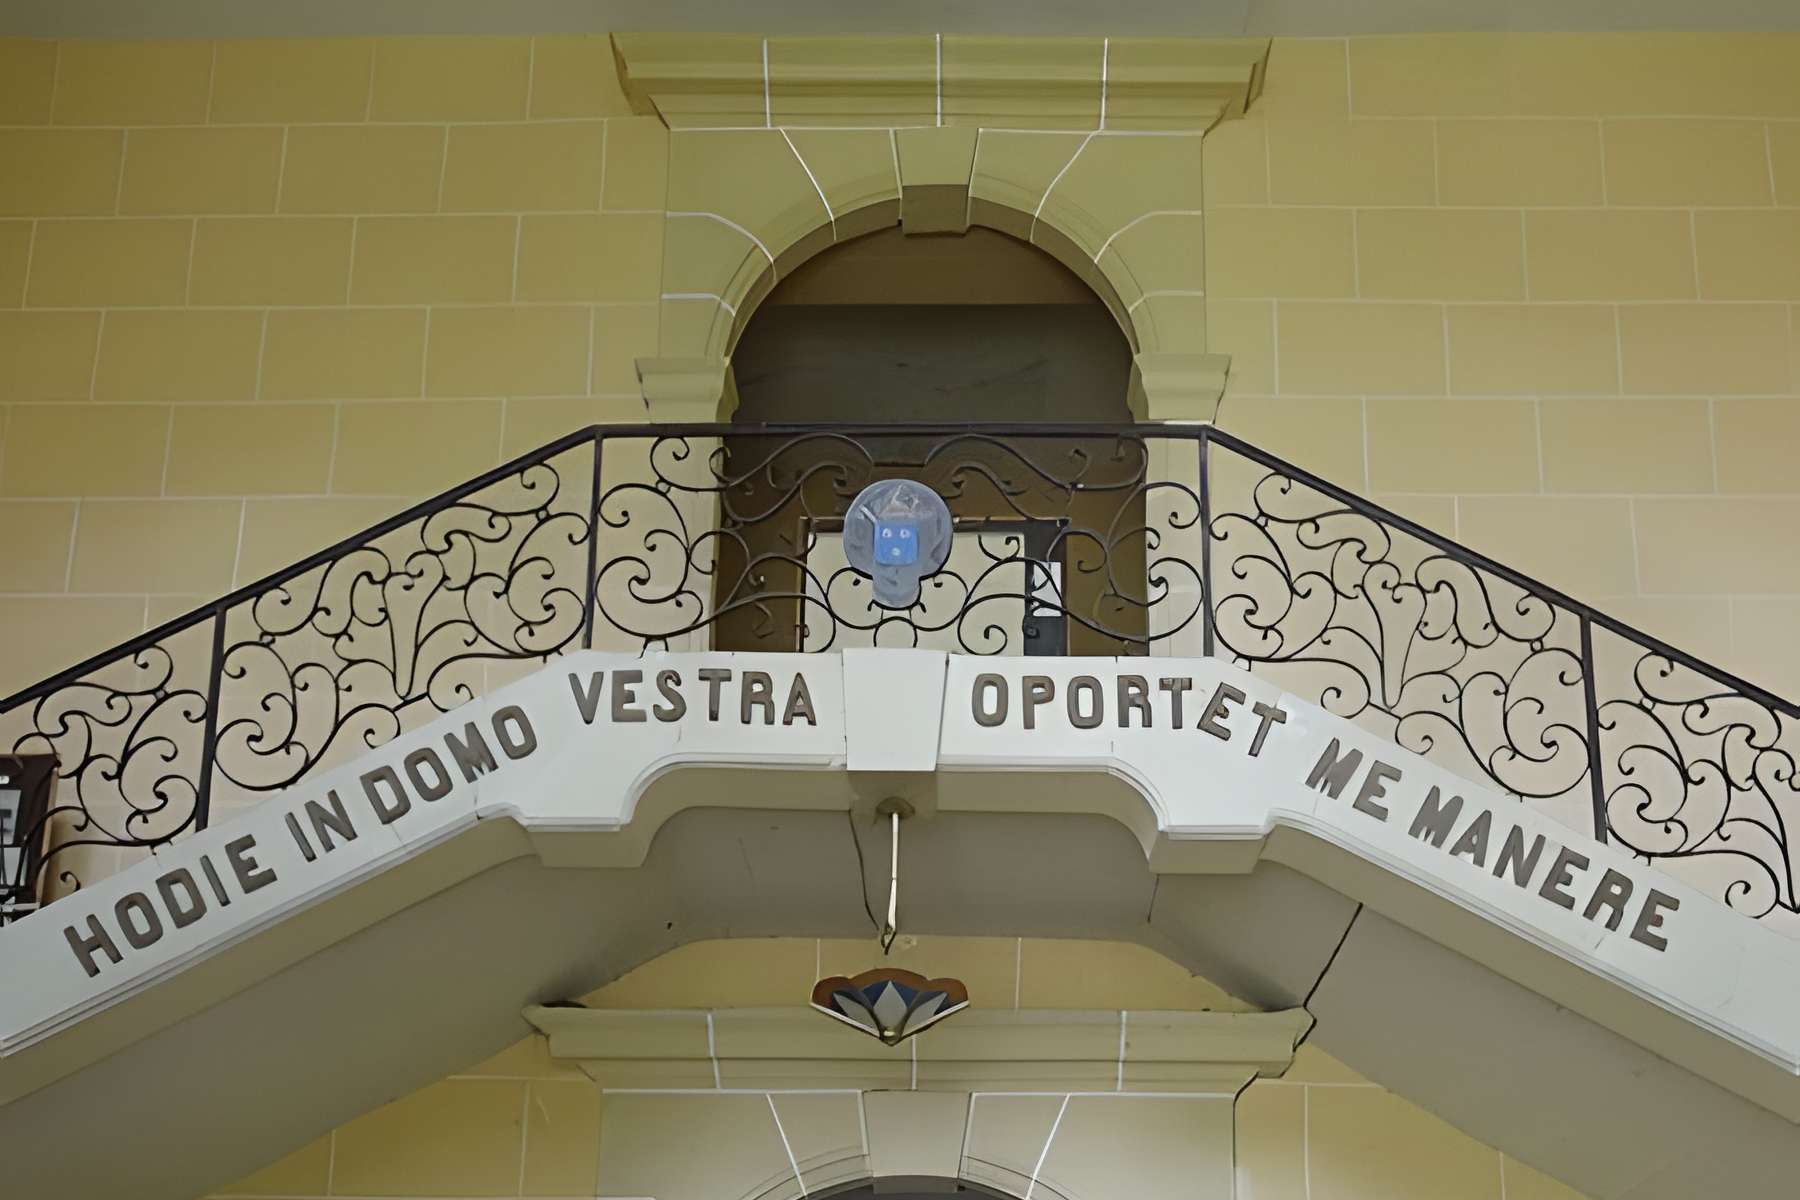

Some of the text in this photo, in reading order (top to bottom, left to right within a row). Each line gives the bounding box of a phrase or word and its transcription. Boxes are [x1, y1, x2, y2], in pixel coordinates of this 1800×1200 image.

[64, 668, 1681, 978] HODIE IN DOMO VESTRA OPORTET ME MANERE
